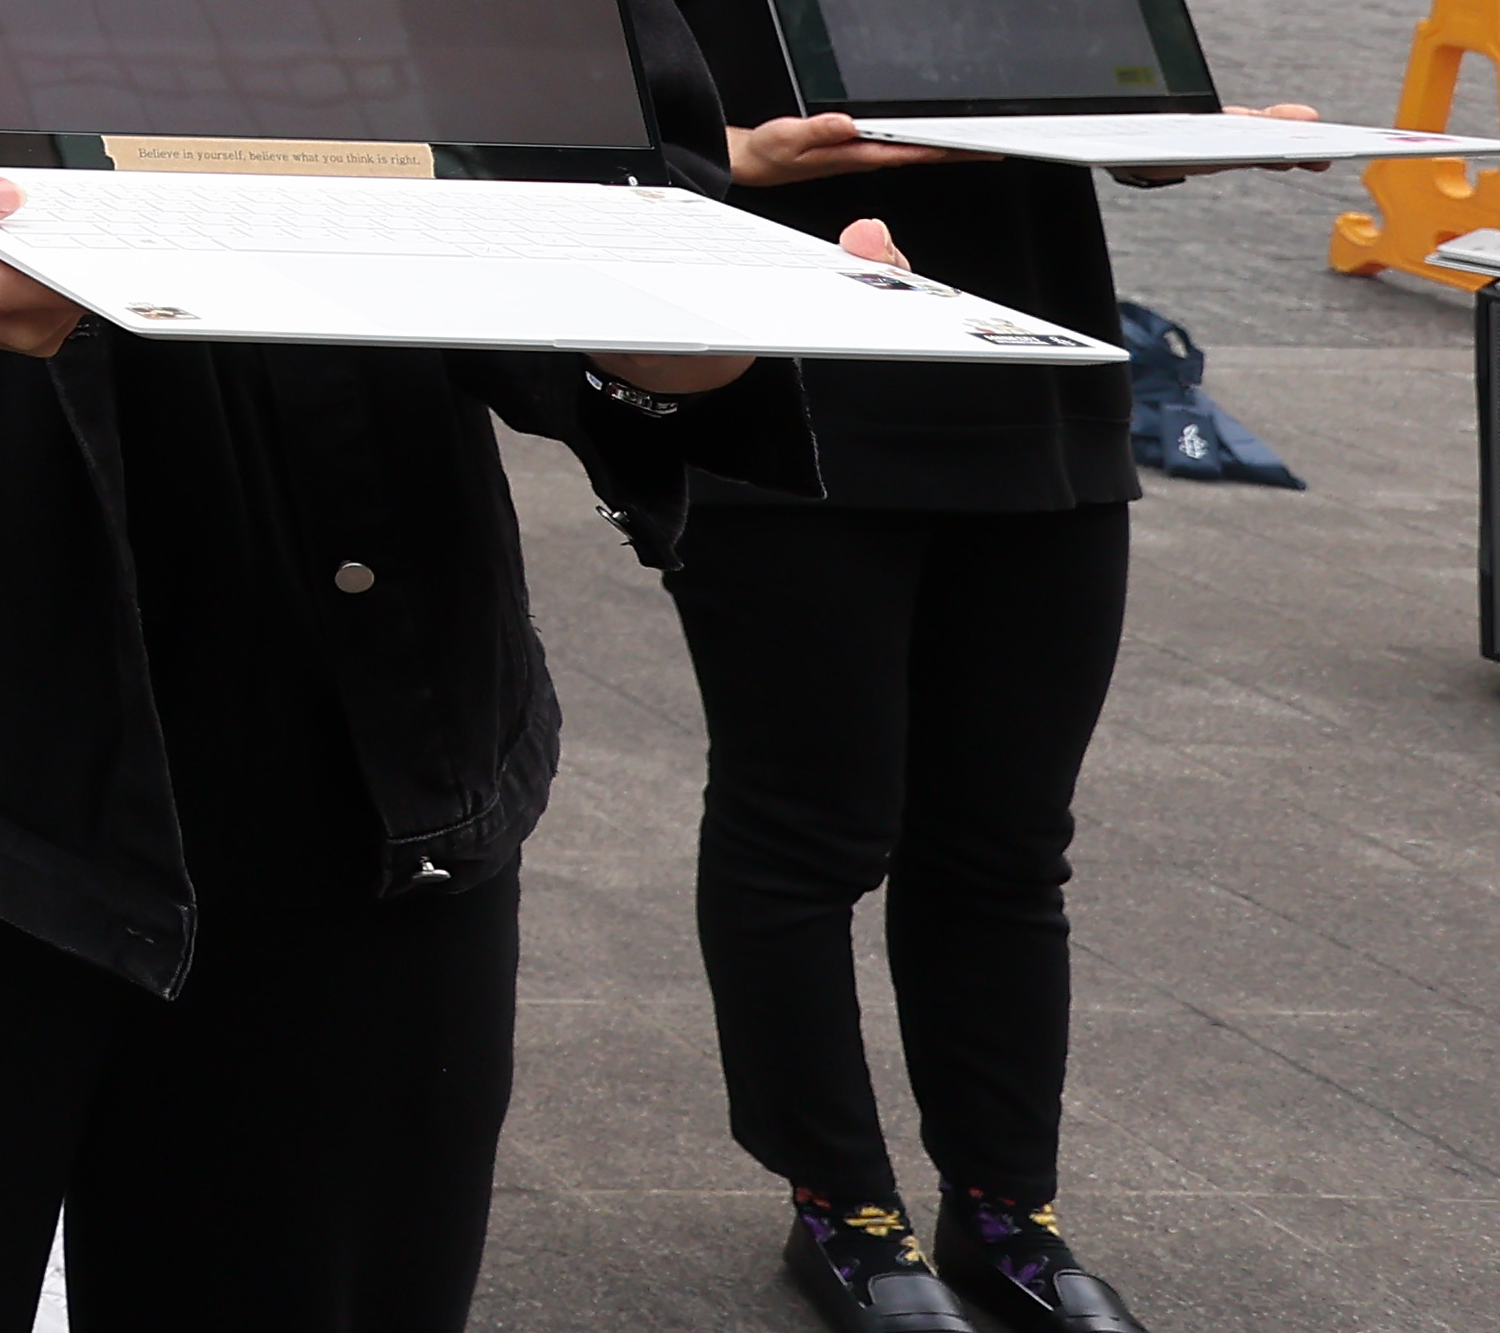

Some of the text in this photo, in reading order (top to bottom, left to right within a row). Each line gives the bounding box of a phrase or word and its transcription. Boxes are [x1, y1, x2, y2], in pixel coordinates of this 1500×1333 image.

[138, 147, 180, 160] Believe
[182, 148, 195, 160] in
[196, 148, 246, 162] yourself,
[248, 150, 289, 163] believe
[292, 152, 319, 164] what
[322, 154, 344, 166] you
[346, 153, 374, 165] think
[390, 154, 421, 167] right.
